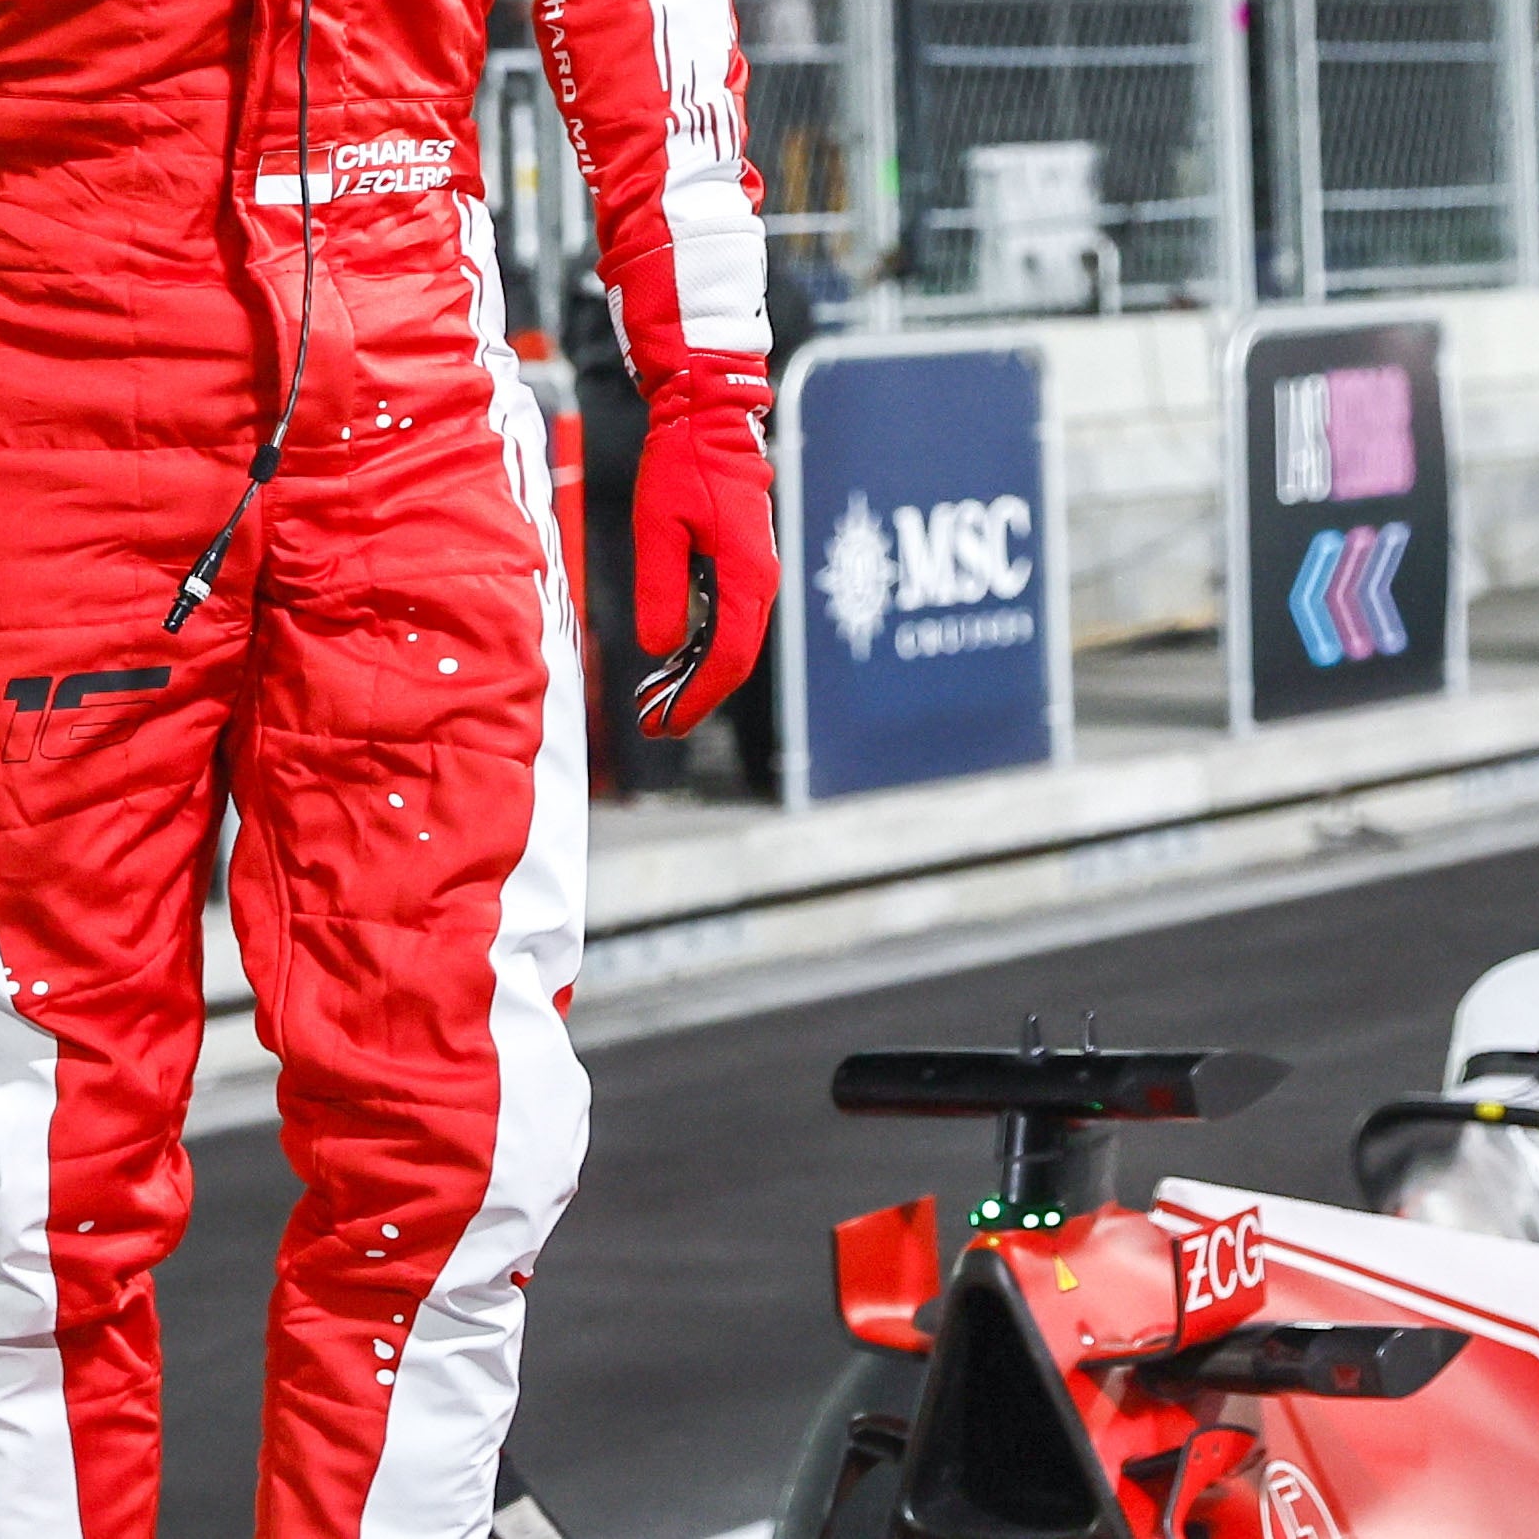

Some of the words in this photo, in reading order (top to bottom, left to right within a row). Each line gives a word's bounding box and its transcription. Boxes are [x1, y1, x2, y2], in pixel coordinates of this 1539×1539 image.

[333, 166, 451, 198] LECLERC
[335, 139, 455, 171] CHARLES
[893, 494, 1033, 612] MSC
[2, 666, 172, 764] 16
[1182, 1214, 1265, 1313] ZCG
